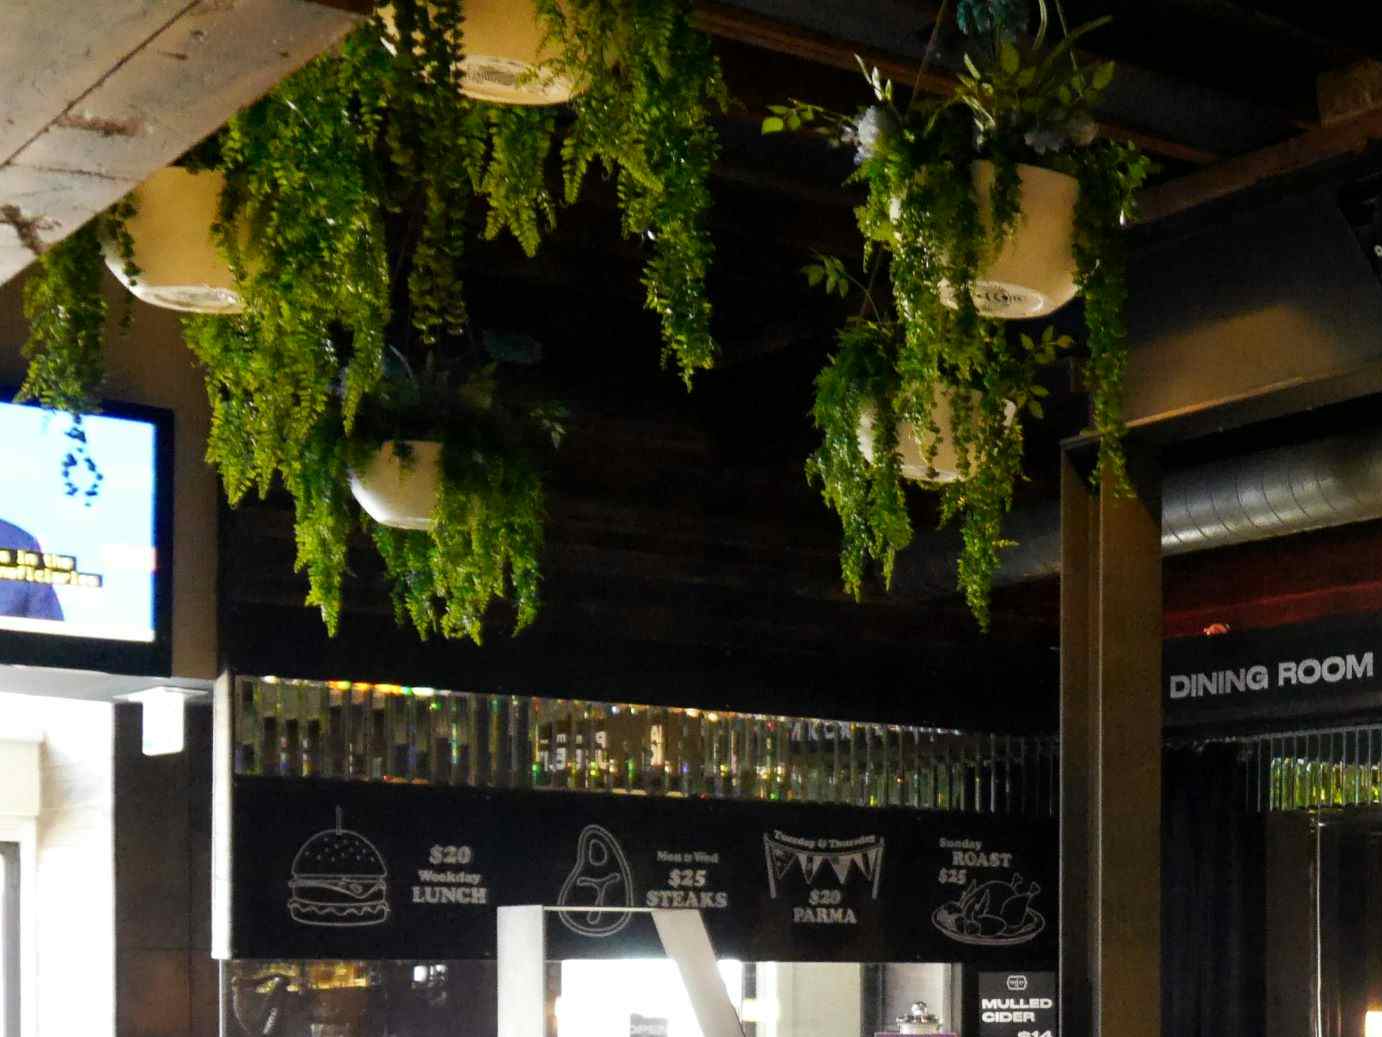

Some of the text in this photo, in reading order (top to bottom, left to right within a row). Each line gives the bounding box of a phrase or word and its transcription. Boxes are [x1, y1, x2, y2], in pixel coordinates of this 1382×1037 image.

[1169, 651, 1374, 699] DINING ROOM
[429, 844, 472, 865] $20
[951, 850, 1013, 868] ROAST
[418, 869, 482, 885] Weekday
[667, 868, 707, 888] $25
[412, 886, 487, 904] LUNCH
[646, 890, 728, 909] STEAKS
[793, 906, 858, 924] PARMA
[981, 998, 1053, 1010] MULLED
[981, 1011, 1036, 1023] CIDER
